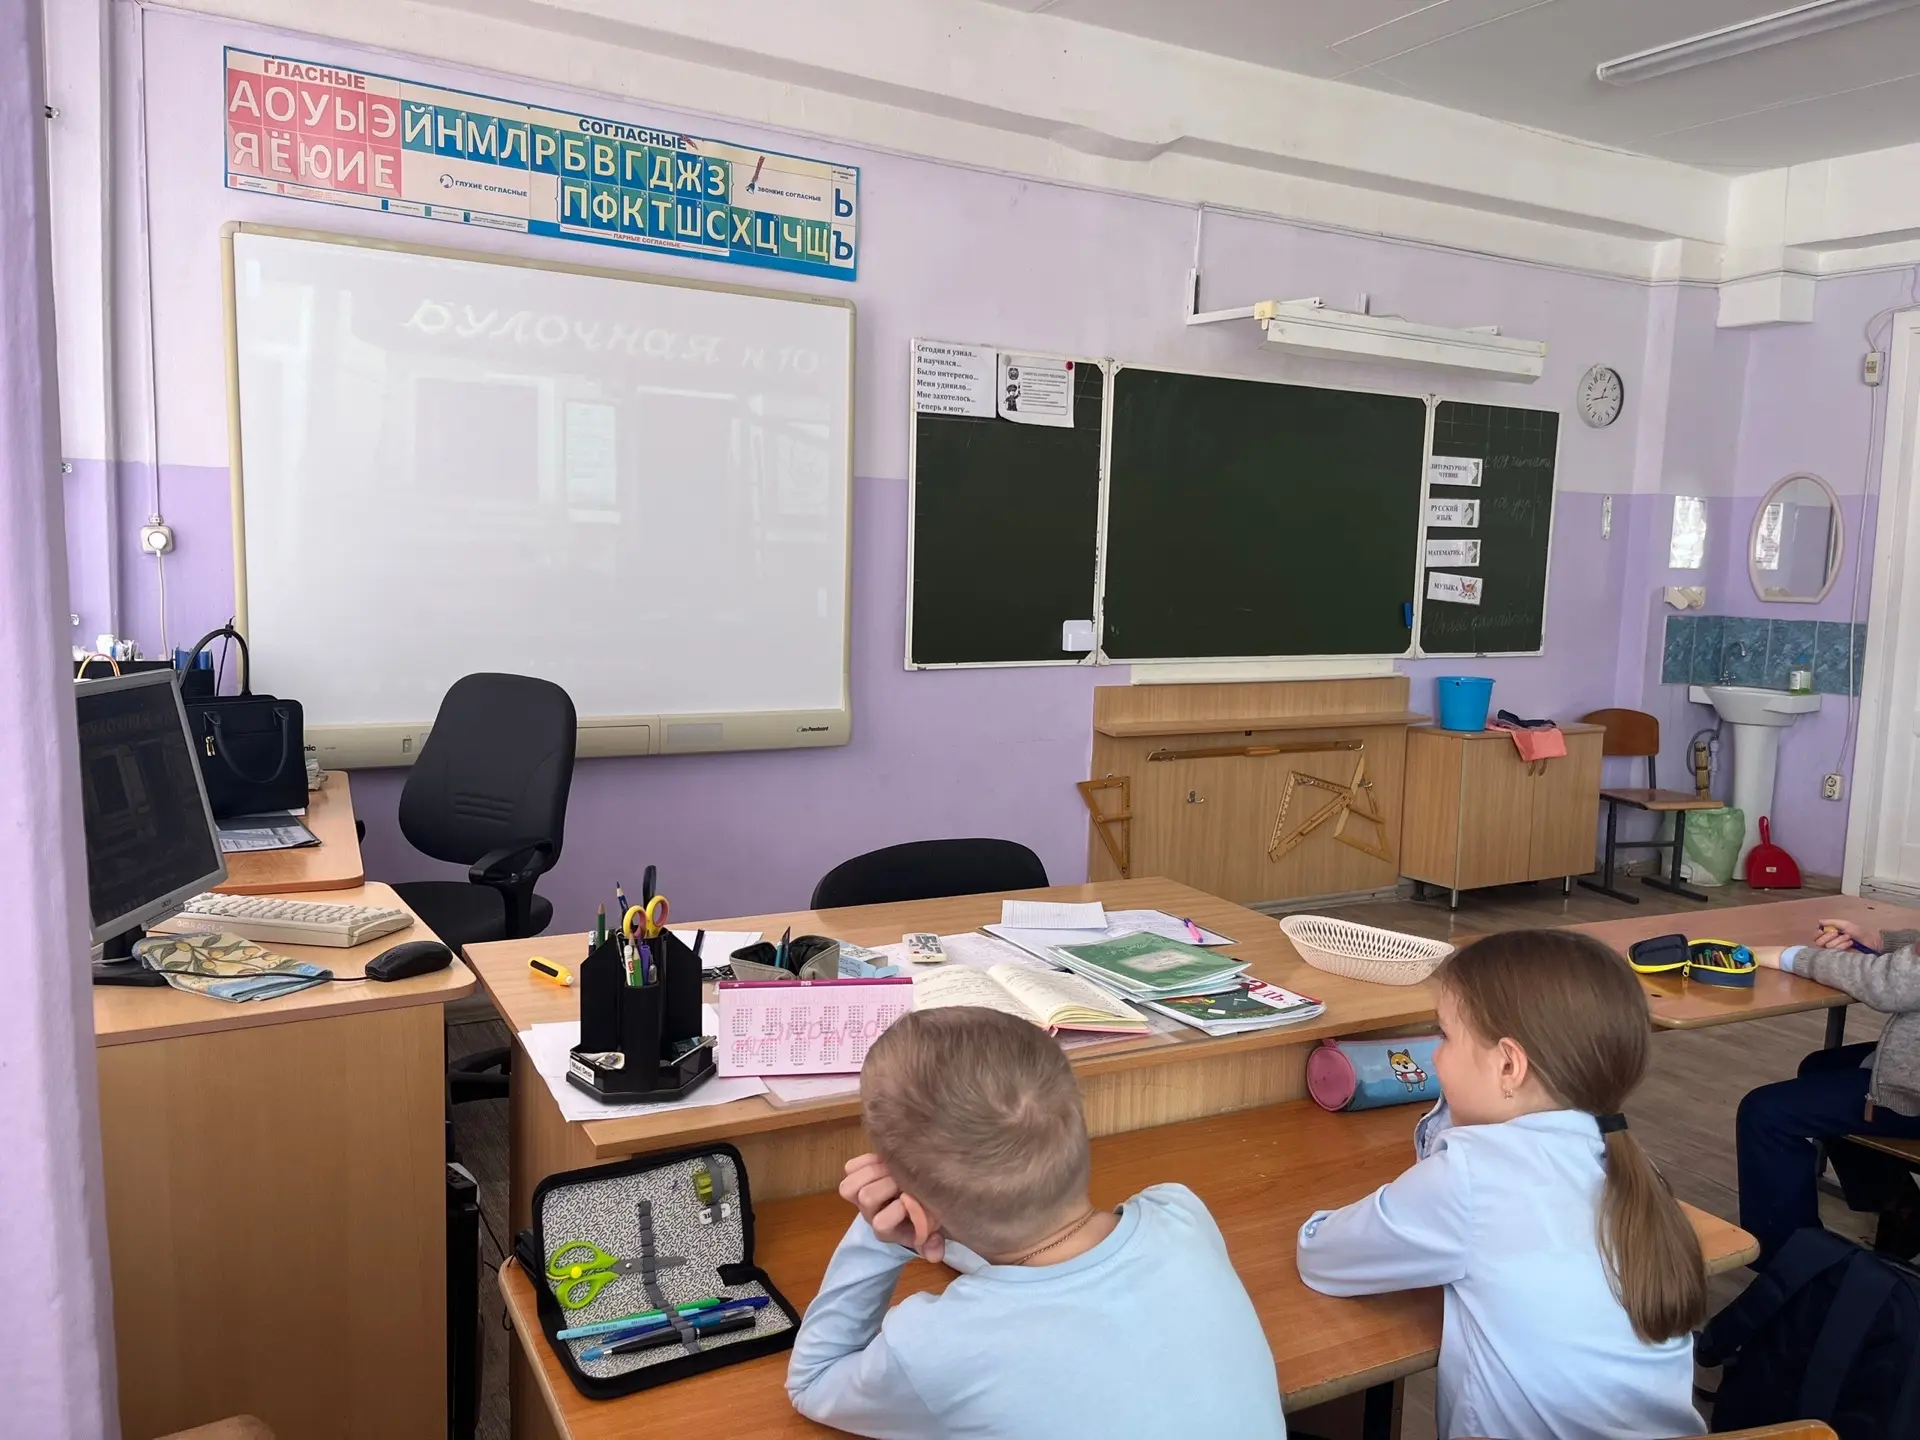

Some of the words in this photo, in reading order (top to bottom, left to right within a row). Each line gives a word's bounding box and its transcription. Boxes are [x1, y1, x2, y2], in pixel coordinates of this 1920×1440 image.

[264, 59, 366, 91] ГЛАСНЫЕ
[578, 118, 687, 151] СОГЛАСНЫЕ
[455, 179, 483, 190] ГЛУХИЕ
[484, 185, 528, 197] СОГЛАСНЫЕ
[757, 186, 784, 197] ЗВОНКИЕ
[785, 190, 822, 202] СОГЛАСНЫЕ
[613, 233, 641, 243] ПАРНЫЕ
[642, 236, 682, 248] СОГЛАСНЫЕ
[917, 344, 945, 354] Сегодня
[917, 368, 937, 377] Было
[917, 379, 936, 388] Меня
[917, 390, 932, 399] Мне
[917, 402, 942, 412] Теперь
[1430, 503, 1459, 512] РУССКИЙ
[1428, 549, 1464, 557] МАТЕМАТИКА
[1433, 582, 1459, 592] МУЗЫКА
